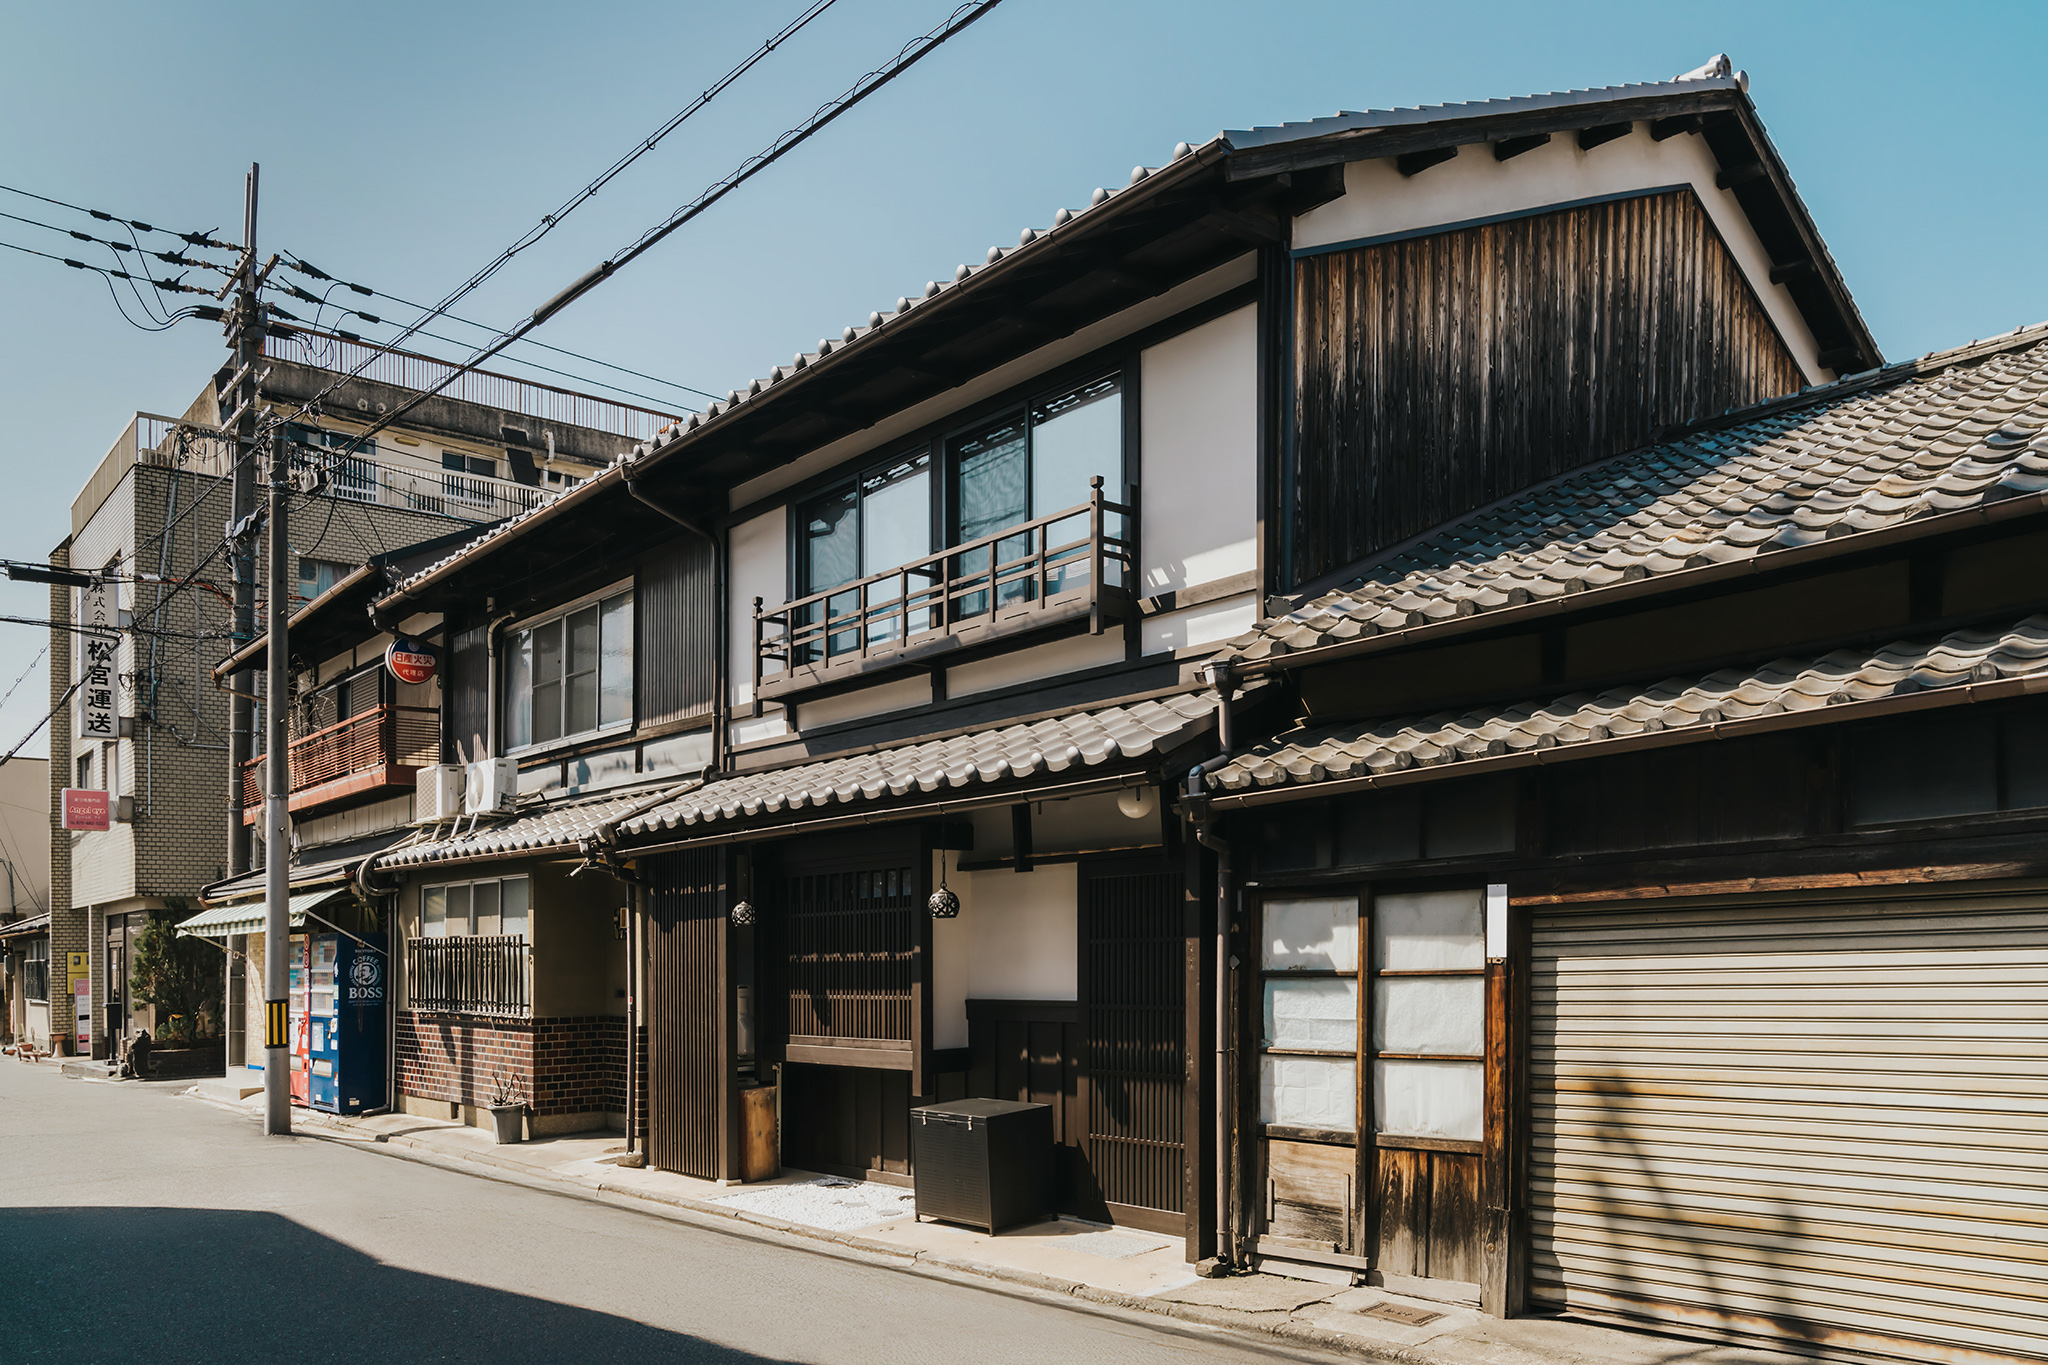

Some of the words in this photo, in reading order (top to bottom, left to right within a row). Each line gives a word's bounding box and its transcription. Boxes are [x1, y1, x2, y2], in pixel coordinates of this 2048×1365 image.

[395, 652, 432, 665] 日産火災
[402, 669, 424, 677] 代理店
[69, 805, 91, 815] Angel
[92, 807, 106, 815] eye
[352, 955, 379, 965] COFFEE
[348, 987, 383, 999] BOSS
